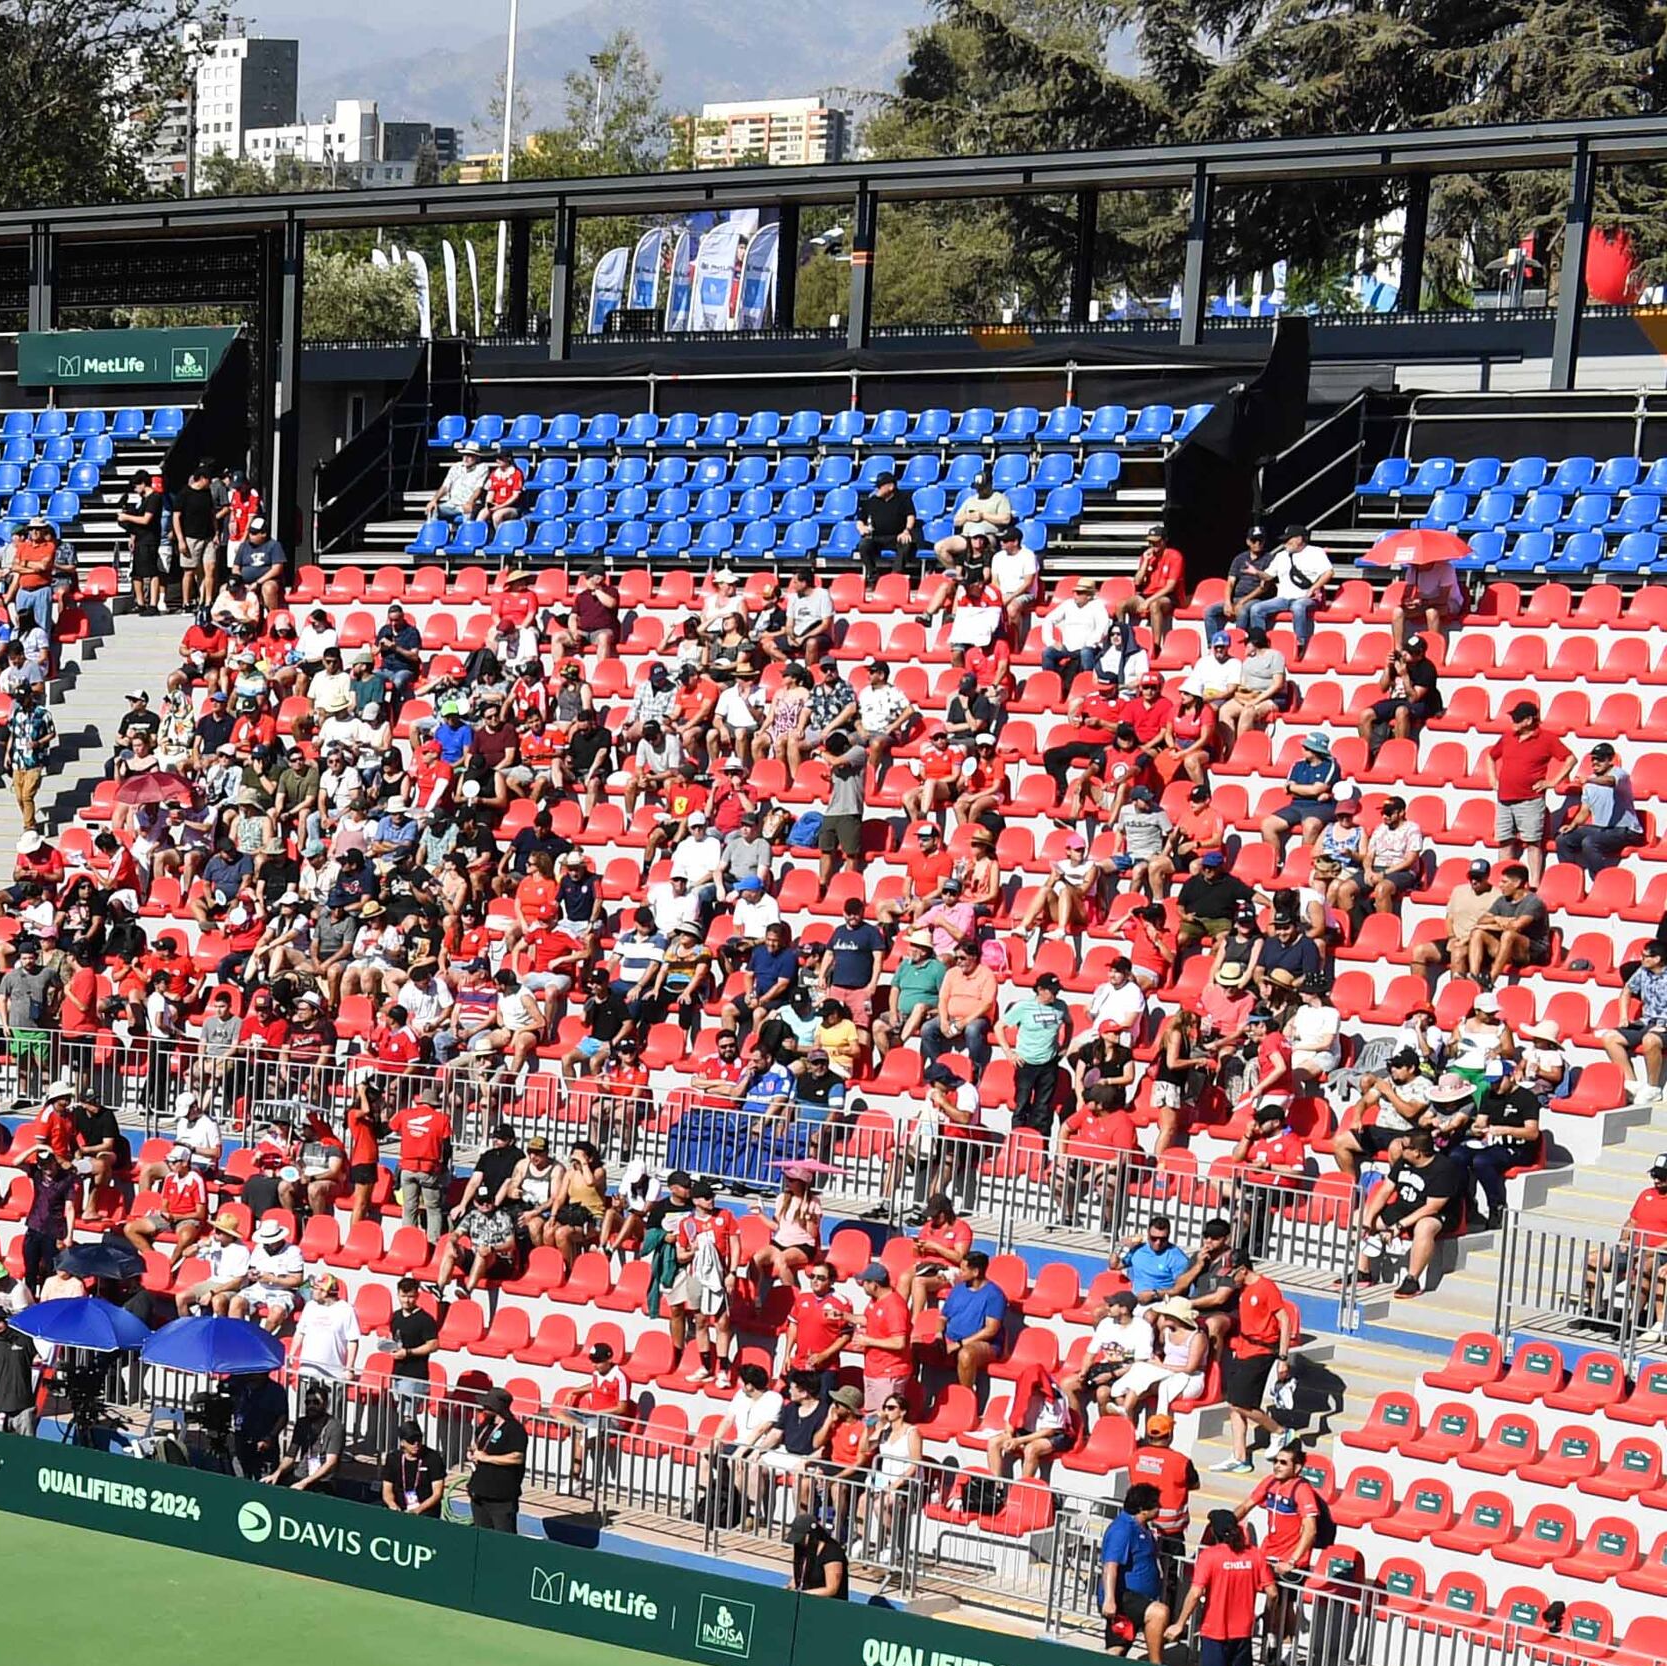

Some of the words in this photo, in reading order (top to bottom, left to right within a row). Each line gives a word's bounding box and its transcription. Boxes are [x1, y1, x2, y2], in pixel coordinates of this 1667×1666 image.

[84, 358, 145, 373] MetLife
[38, 1467, 147, 1510] QUALIFIERS
[150, 1489, 201, 1521] 2024
[279, 1515, 362, 1556] DAVIS
[369, 1537, 434, 1569] CUP
[569, 1580, 658, 1621] MetLife
[702, 1623, 744, 1644] INDISA
